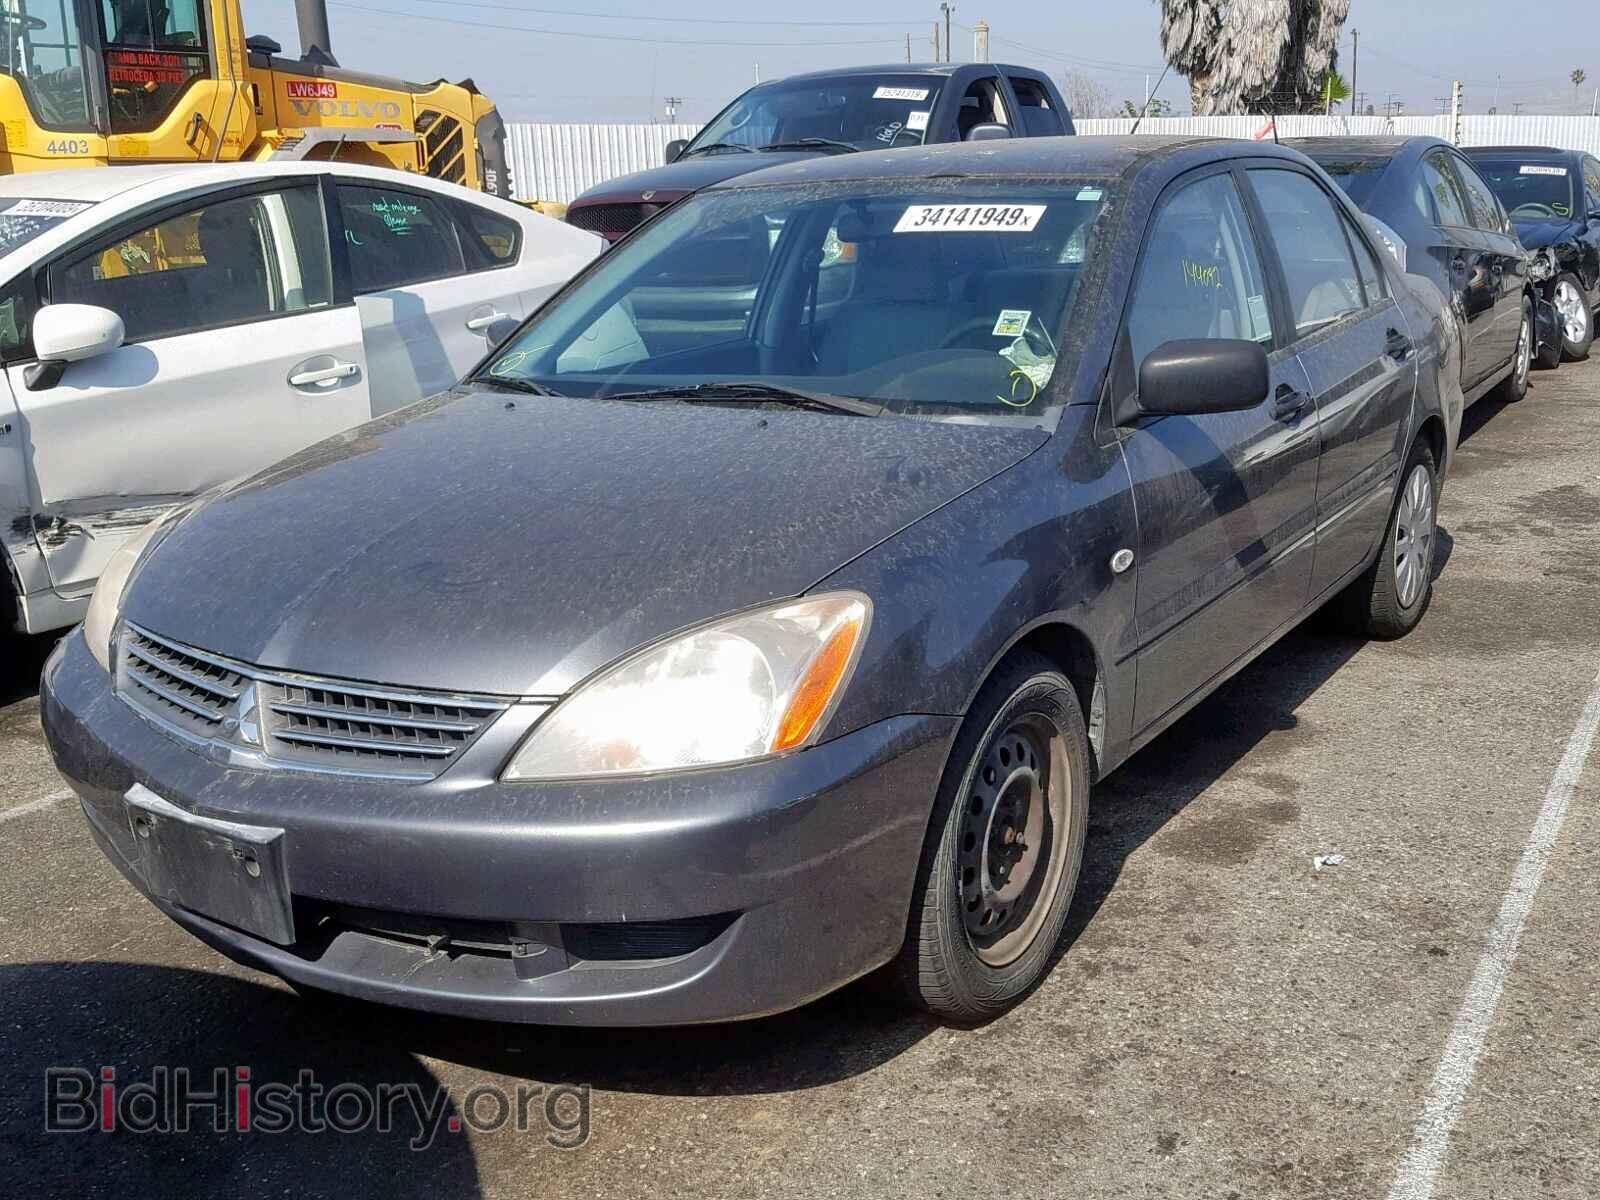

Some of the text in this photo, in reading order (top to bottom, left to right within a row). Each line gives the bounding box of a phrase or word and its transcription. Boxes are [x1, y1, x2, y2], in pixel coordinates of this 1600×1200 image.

[138, 53, 161, 65] BACK
[287, 82, 335, 97] LW6J49
[288, 99, 401, 118] VOLVO
[47, 140, 89, 154] 4403
